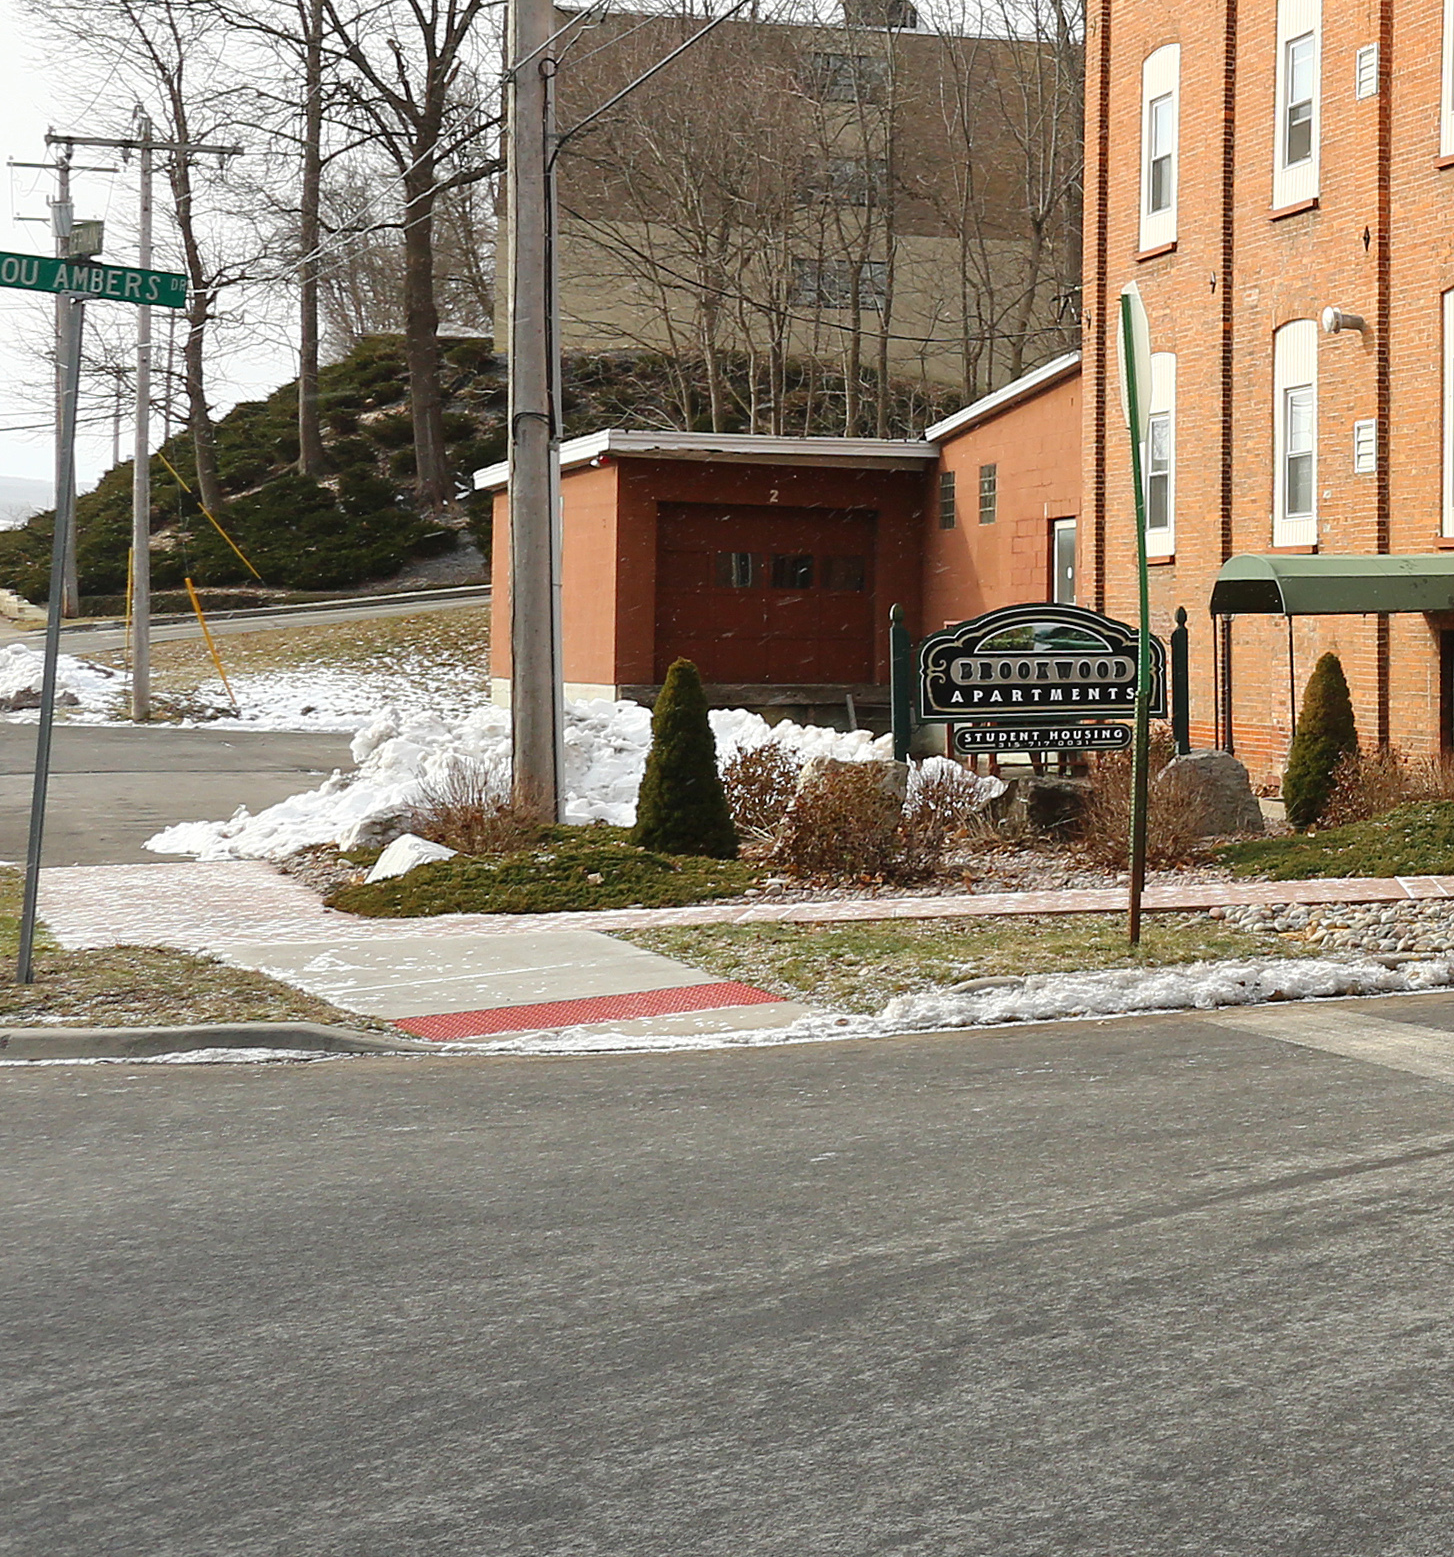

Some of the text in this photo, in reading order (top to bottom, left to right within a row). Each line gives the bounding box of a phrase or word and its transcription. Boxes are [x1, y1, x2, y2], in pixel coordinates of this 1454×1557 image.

[53, 263, 161, 301] AMBERS
[770, 489, 779, 503] 2
[958, 659, 1128, 681] BROOKWOOD
[950, 687, 1135, 703] APARTMENTS
[964, 729, 1123, 742] STUDENT HOUSING
